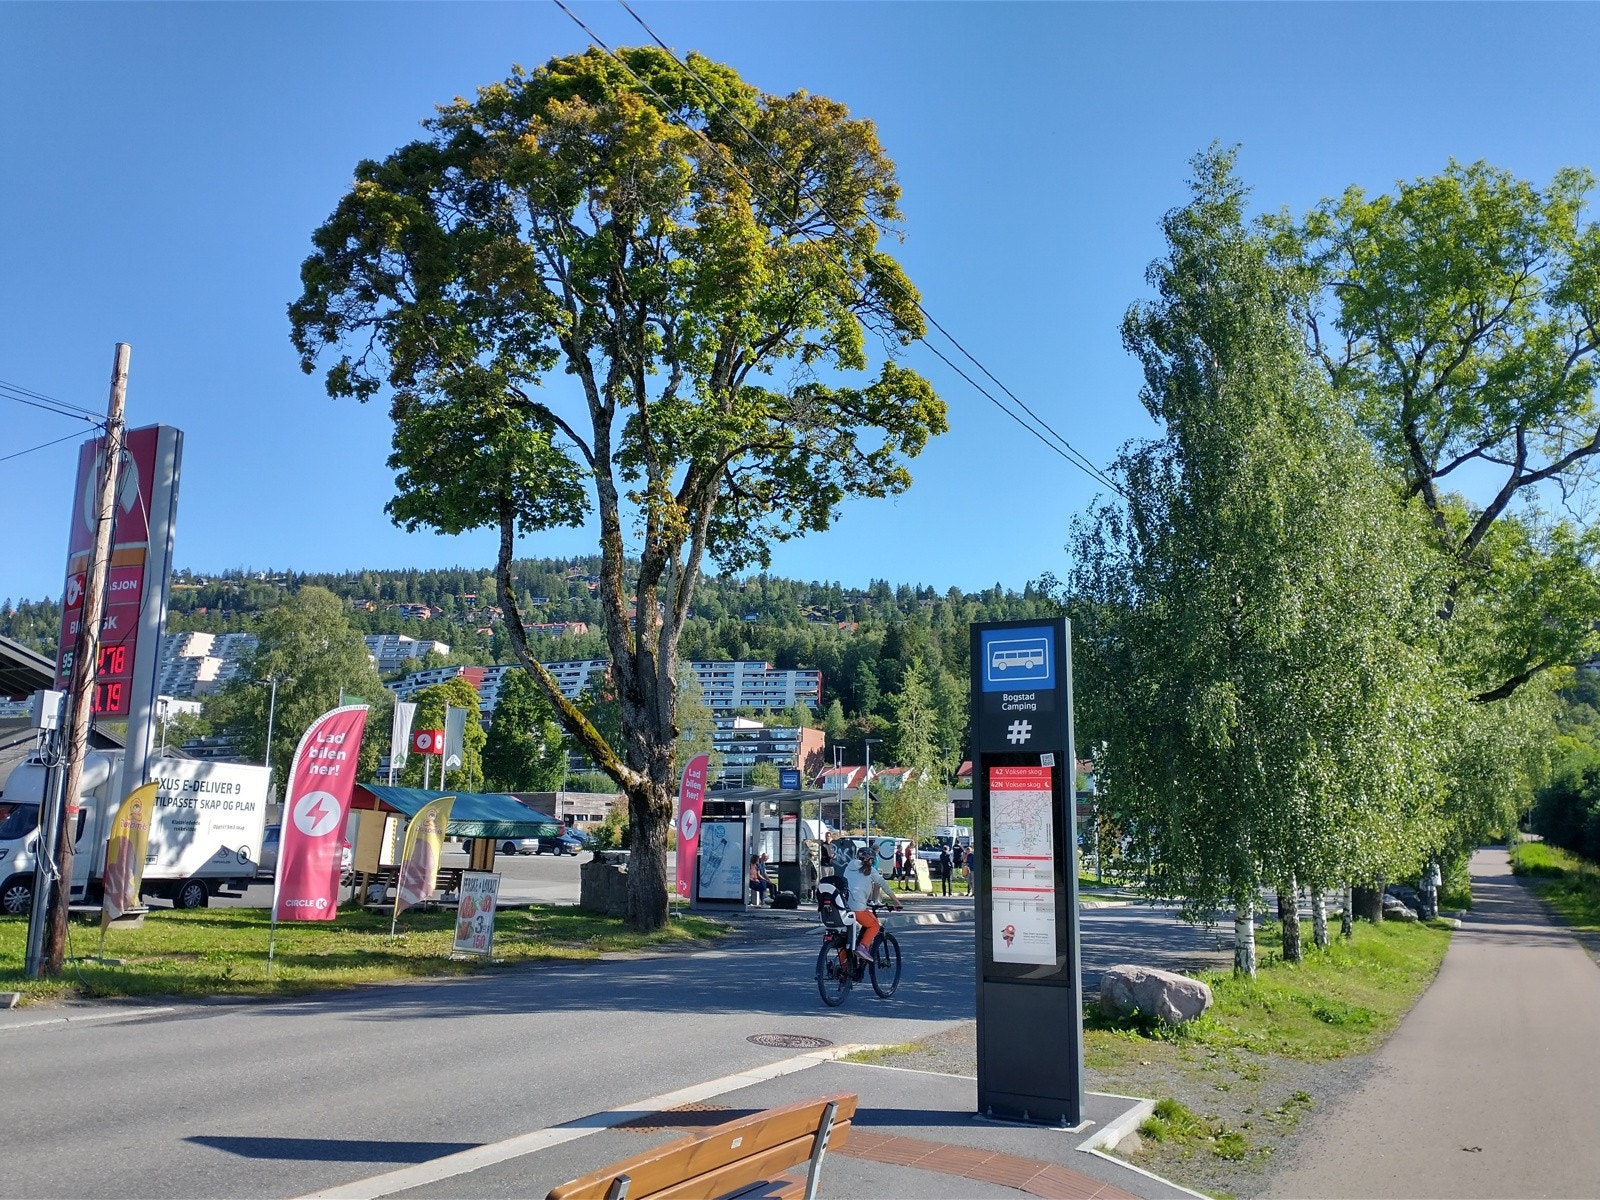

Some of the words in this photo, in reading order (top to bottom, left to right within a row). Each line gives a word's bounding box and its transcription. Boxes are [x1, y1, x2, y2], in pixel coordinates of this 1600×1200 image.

[1003, 693, 1035, 702] Bogstad
[1001, 702, 1037, 711] Camping
[316, 731, 346, 744] Lad
[308, 746, 347, 760] bilen
[309, 762, 340, 776] her!
[688, 768, 701, 779] Lad
[1028, 768, 1043, 776] skog
[150, 777, 180, 791] AXUS
[182, 780, 233, 794] E-DELIVER
[235, 783, 241, 795] 9
[685, 778, 702, 790] bilen
[990, 780, 1004, 788] 42N
[1027, 781, 1041, 789] skog
[686, 789, 699, 801] her!
[154, 796, 199, 809] TILPASSET
[200, 799, 221, 810] SKAP
[222, 800, 234, 811] OG
[235, 801, 256, 811] PLAN
[285, 899, 315, 907] CIRCLE
